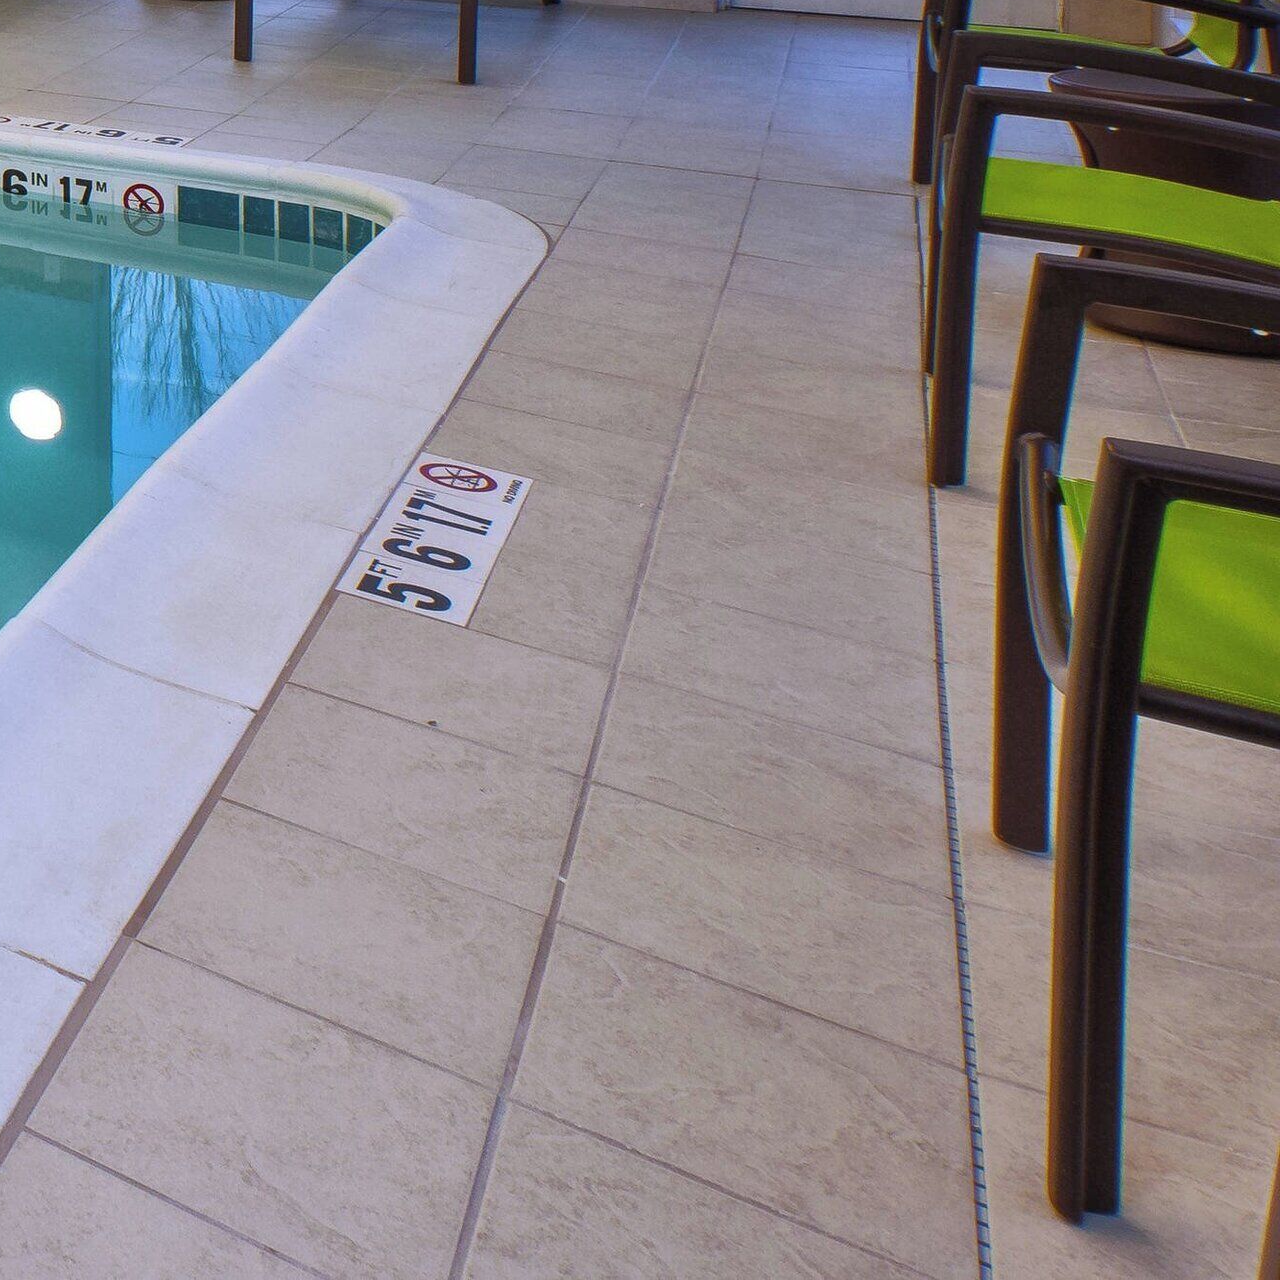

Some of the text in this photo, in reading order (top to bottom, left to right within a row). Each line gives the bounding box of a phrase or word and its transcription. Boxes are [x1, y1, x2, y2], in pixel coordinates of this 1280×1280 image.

[2, 169, 28, 196] 6
[31, 172, 48, 188] IN
[95, 181, 107, 193] M
[414, 488, 437, 501] M
[390, 522, 425, 540] IN
[382, 537, 473, 571] 6
[368, 558, 403, 579] FT
[356, 574, 453, 612] 5
